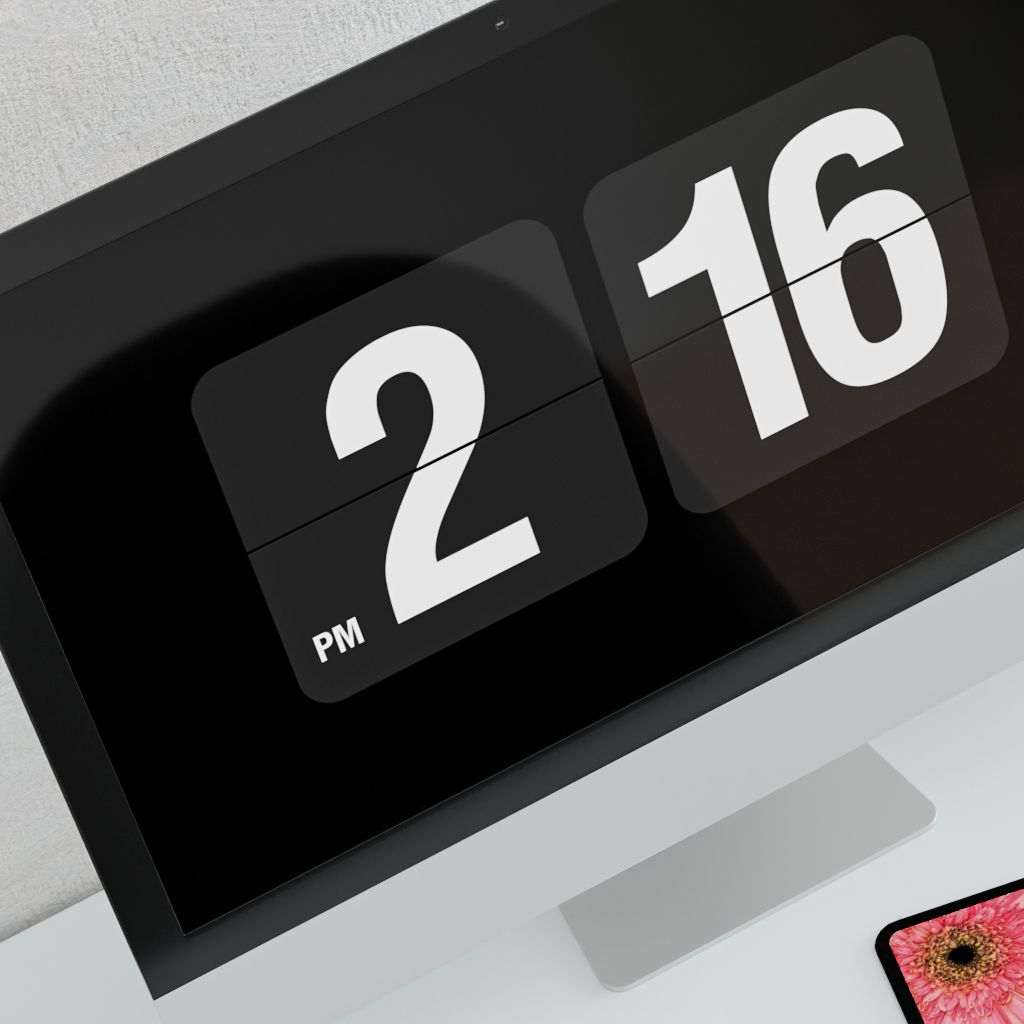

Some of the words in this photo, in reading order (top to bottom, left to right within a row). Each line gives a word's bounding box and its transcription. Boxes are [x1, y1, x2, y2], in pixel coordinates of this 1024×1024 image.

[325, 324, 541, 624] 2
[637, 107, 948, 440] 16
[311, 616, 365, 663] PM
